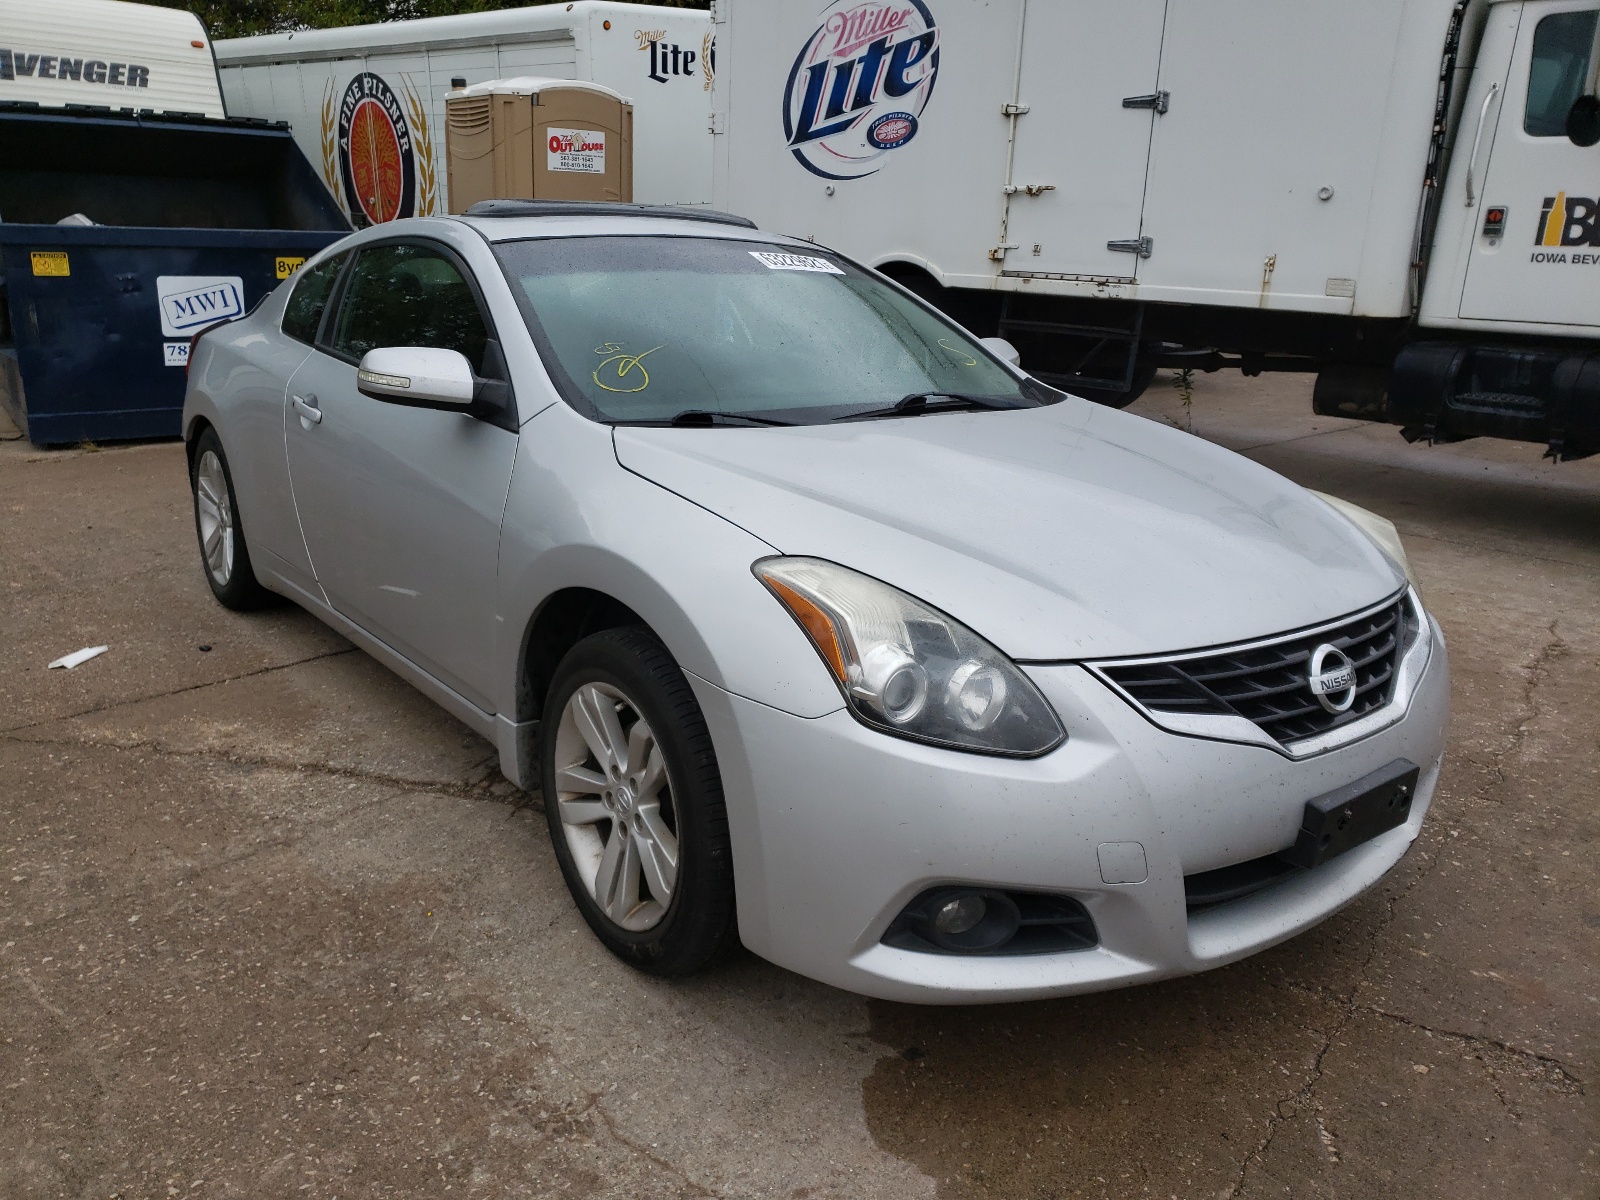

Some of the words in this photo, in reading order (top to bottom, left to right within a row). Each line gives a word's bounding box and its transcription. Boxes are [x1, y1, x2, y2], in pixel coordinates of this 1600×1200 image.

[634, 29, 667, 47] Miller
[826, 6, 914, 50] Miller
[647, 40, 696, 84] Lite
[341, 82, 362, 130] FINE
[788, 29, 938, 146] Lite
[363, 77, 410, 154] PILSNER
[340, 137, 348, 152] A
[1535, 196, 1600, 247] iB
[1530, 252, 1567, 264] IOWA
[1571, 254, 1600, 265] BEV
[171, 288, 231, 320] MWI
[166, 344, 192, 357] 78
